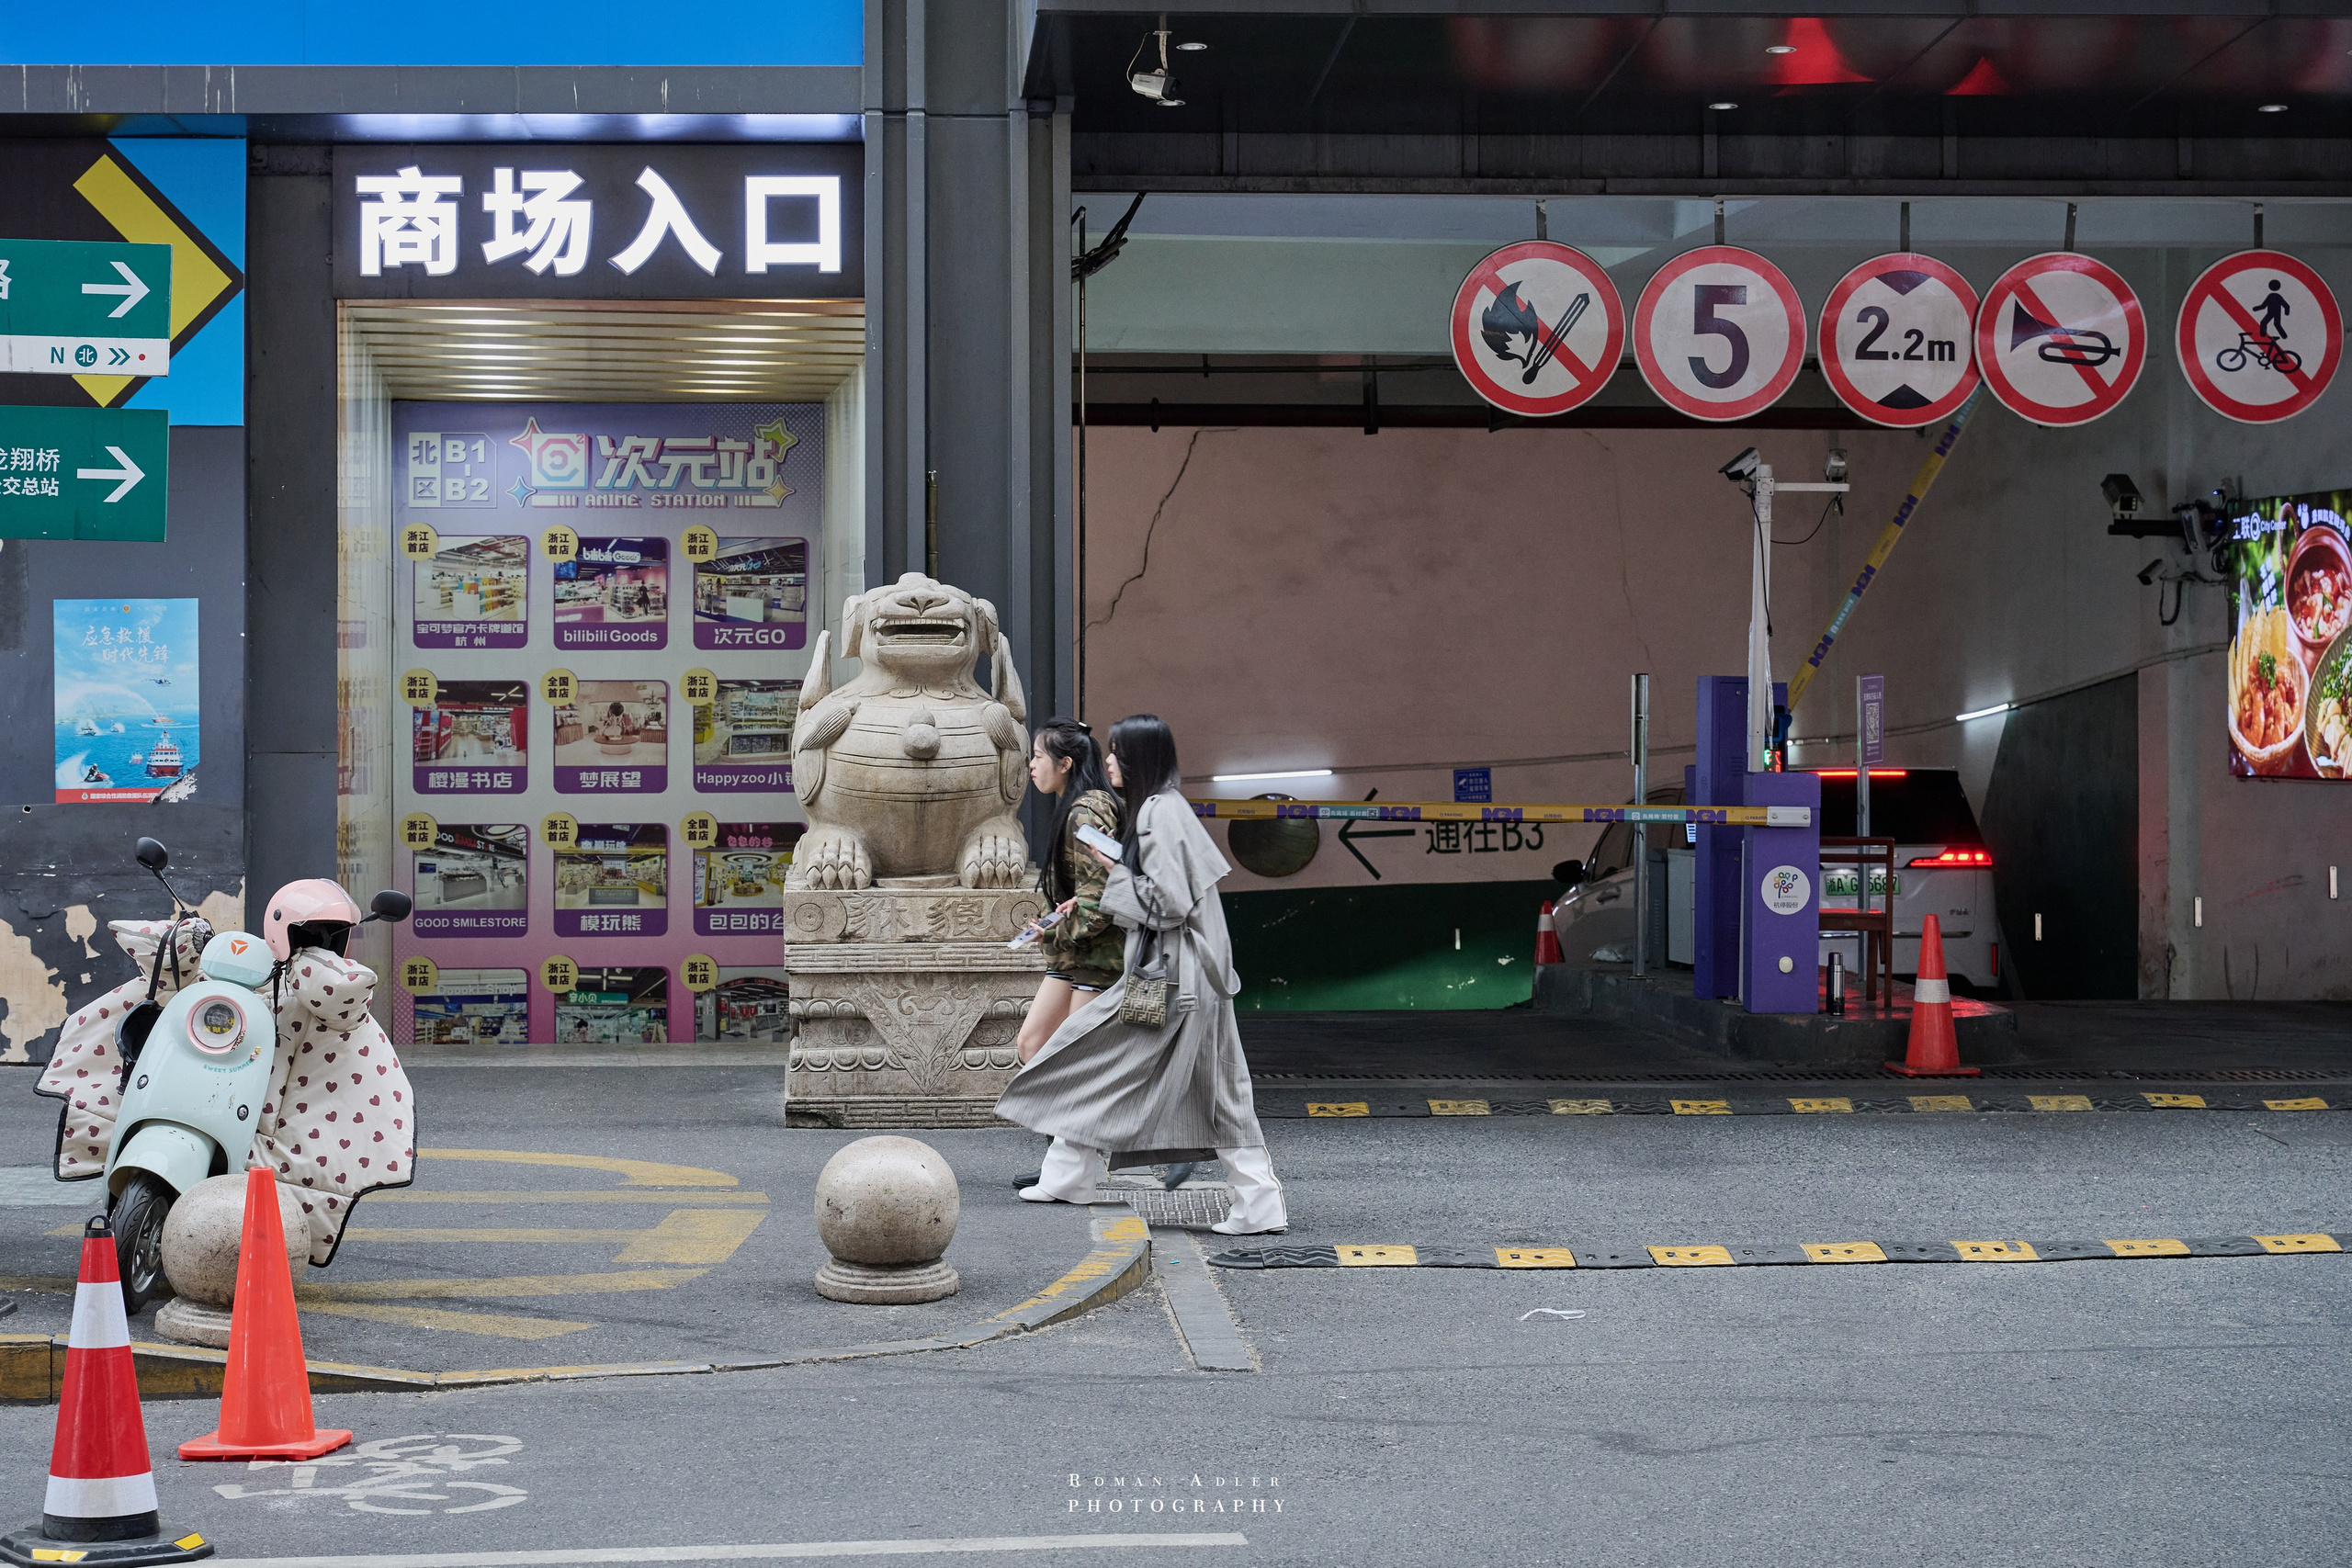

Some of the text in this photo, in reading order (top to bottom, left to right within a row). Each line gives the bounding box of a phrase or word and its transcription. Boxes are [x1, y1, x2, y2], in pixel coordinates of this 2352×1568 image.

[356, 165, 842, 276] 商场入口
[1688, 284, 1750, 389] 5
[1854, 305, 1956, 362] 2.2m
[51, 346, 95, 364] N 北
[446, 440, 486, 464] B1
[595, 434, 781, 491] 次元站
[0, 476, 60, 497] 交总站
[446, 479, 490, 502] B2
[585, 493, 729, 507] ANIME STATION
[407, 531, 429, 542] 浙江
[548, 533, 570, 543] 浙江
[687, 533, 709, 543] 浙江
[407, 543, 429, 553] 首店
[548, 545, 570, 555] 首店
[687, 545, 709, 555] 首店
[416, 623, 525, 634] 宝可梦官方卡牌道馆
[82, 625, 155, 647] 应急救援
[563, 629, 658, 642] bilibili Goods
[714, 628, 786, 645] 次元GO
[455, 636, 486, 647] 杭州
[102, 644, 173, 663] 时代先锋
[407, 676, 429, 687] 浙江
[548, 676, 570, 687] 全国
[687, 676, 709, 686] 浙江
[407, 688, 429, 699] 首店
[548, 688, 570, 699] 首店
[687, 688, 709, 698] 首店
[428, 772, 513, 788] 樱漫书店
[579, 771, 641, 788] 梦展望
[696, 773, 740, 786] Happy
[741, 773, 765, 784] zoo
[407, 820, 429, 830] 浙江
[548, 820, 570, 830] 浙江
[687, 819, 709, 829] 全国
[407, 832, 429, 842] 首店
[548, 831, 570, 842] 首店
[687, 830, 709, 840] 首店
[414, 918, 526, 928] GOOD SMILESTORE
[580, 914, 641, 931] 模玩熊
[407, 964, 429, 975] 浙江
[548, 964, 570, 974] 浙江
[687, 962, 709, 972] 浙江
[407, 976, 429, 987] 首店
[548, 975, 570, 985] 首店
[687, 974, 709, 984] 首店
[202, 1064, 227, 1073] SWEET
